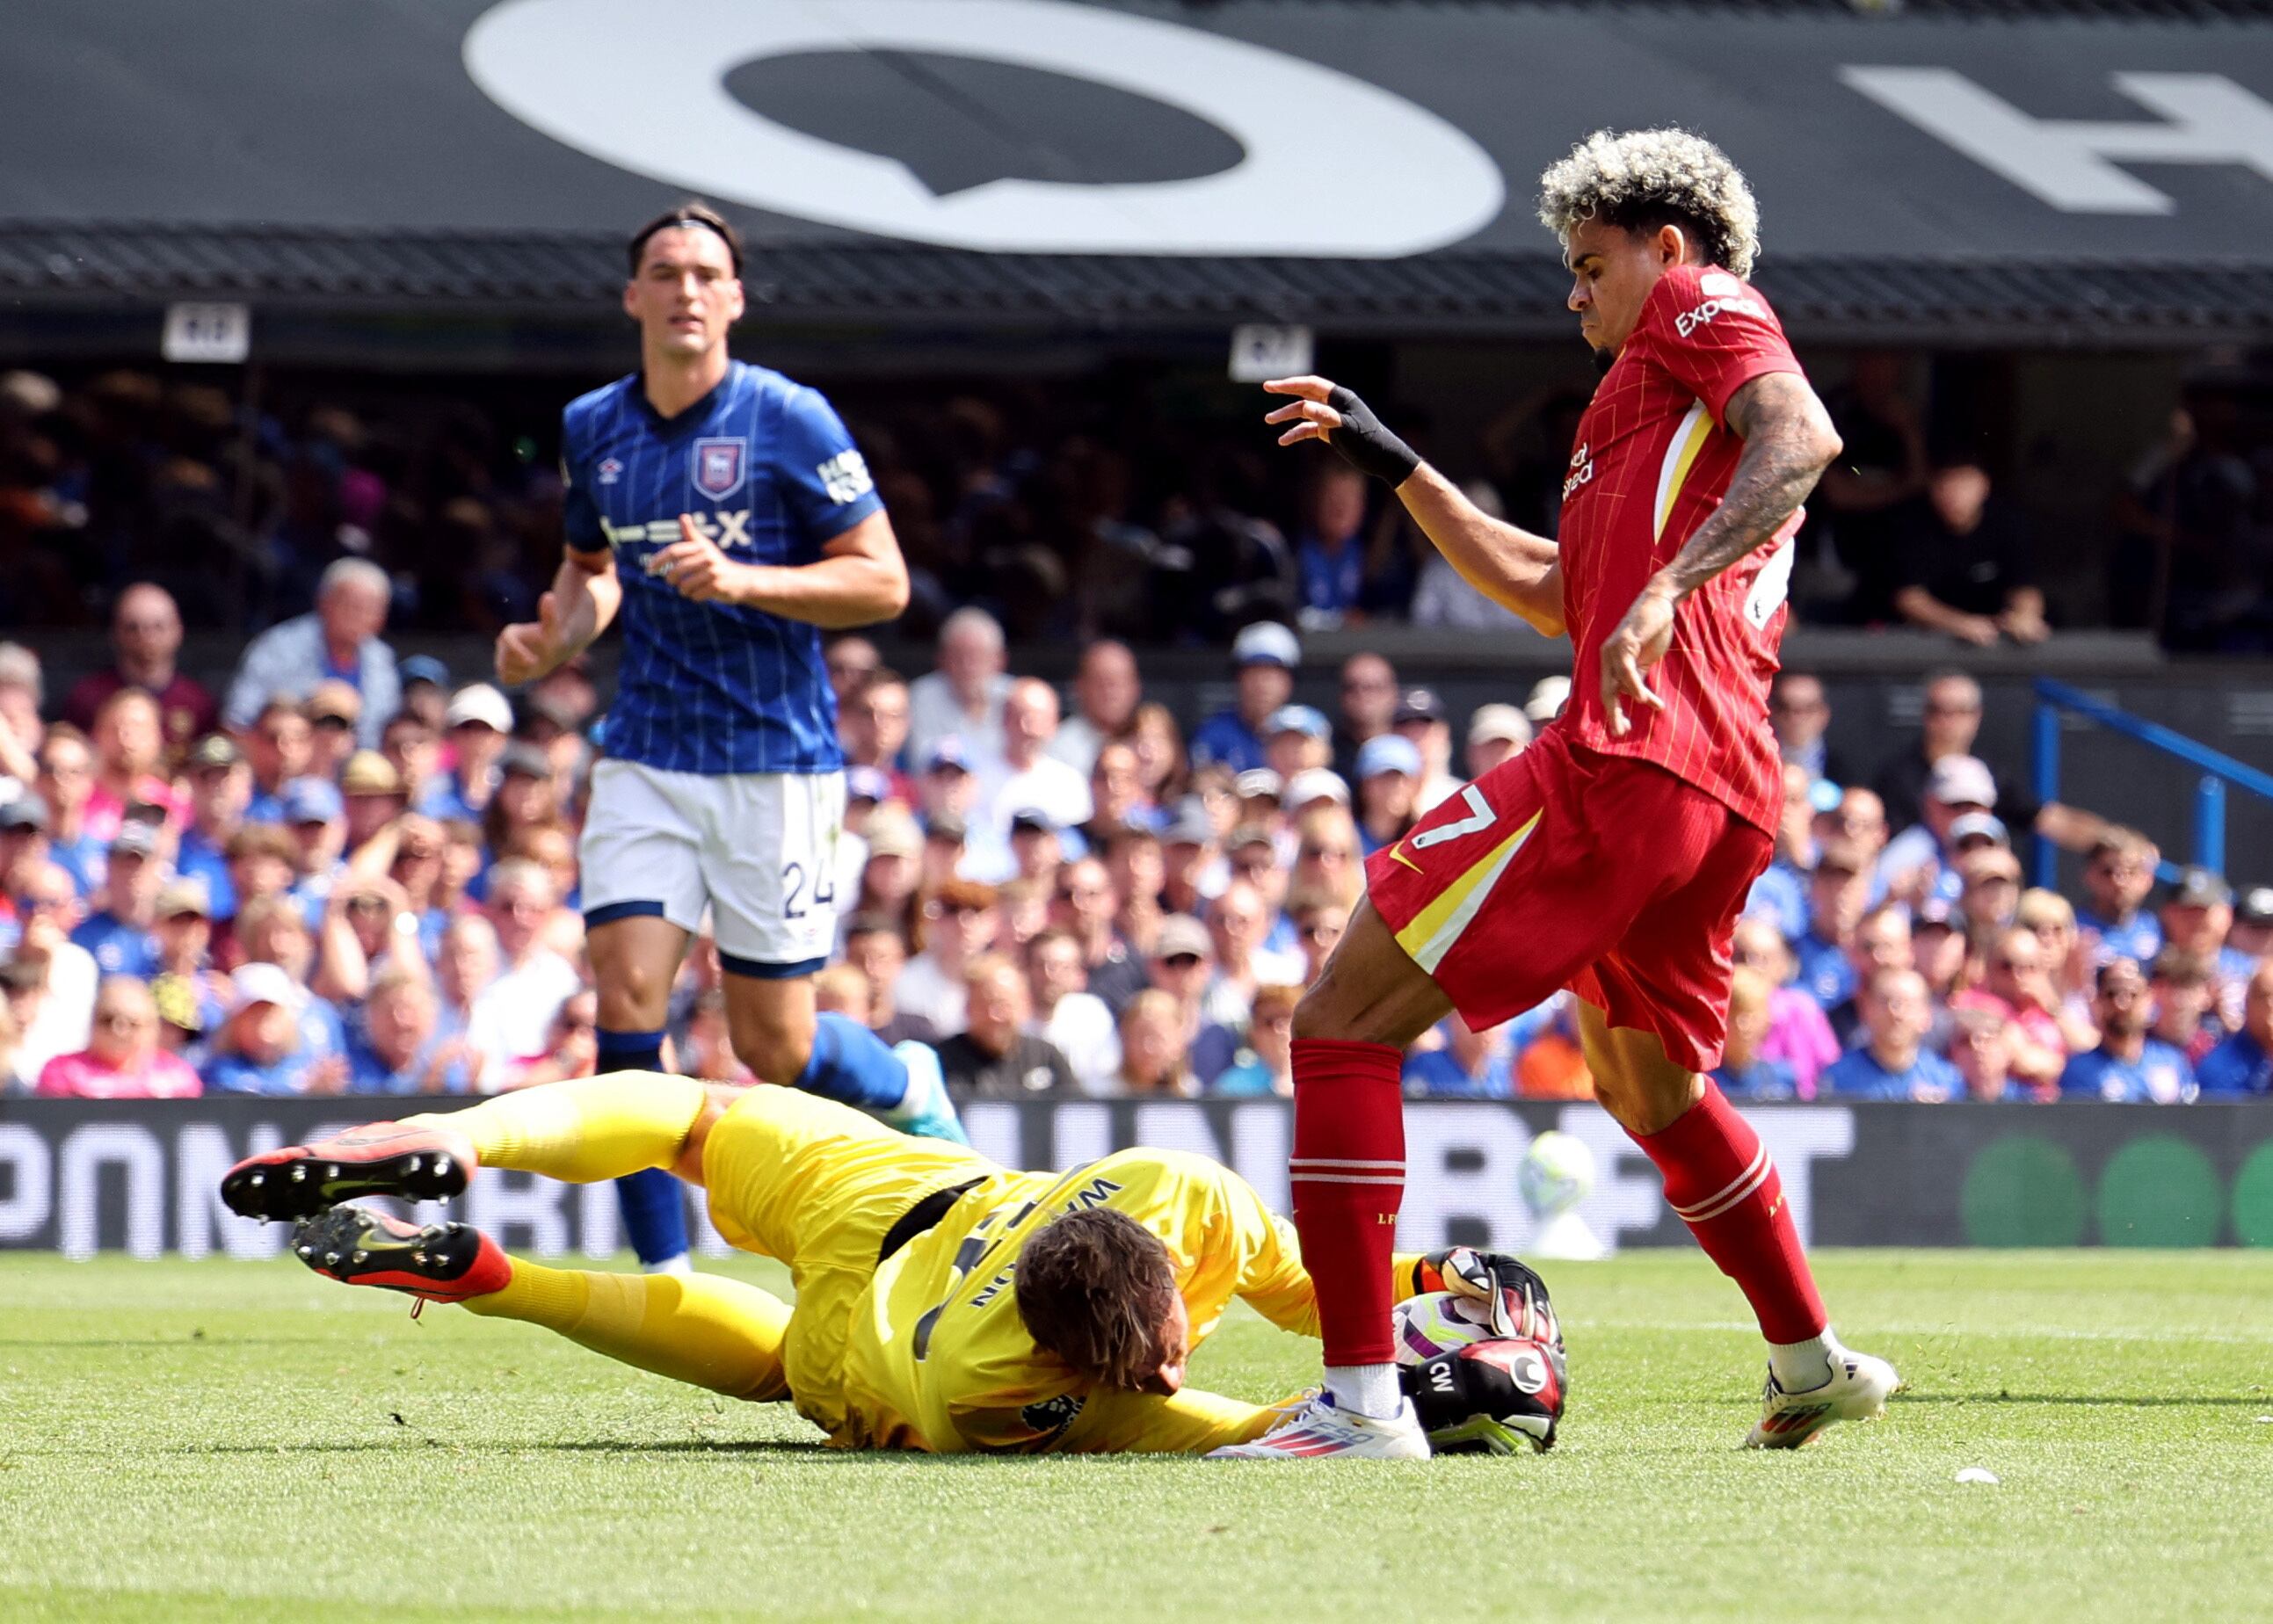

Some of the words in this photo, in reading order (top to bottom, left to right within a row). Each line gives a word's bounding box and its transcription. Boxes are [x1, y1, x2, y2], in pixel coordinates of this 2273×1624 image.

[1412, 784, 1498, 850] 7
[782, 861, 834, 919] 24
[1429, 1361, 1456, 1392] CW
